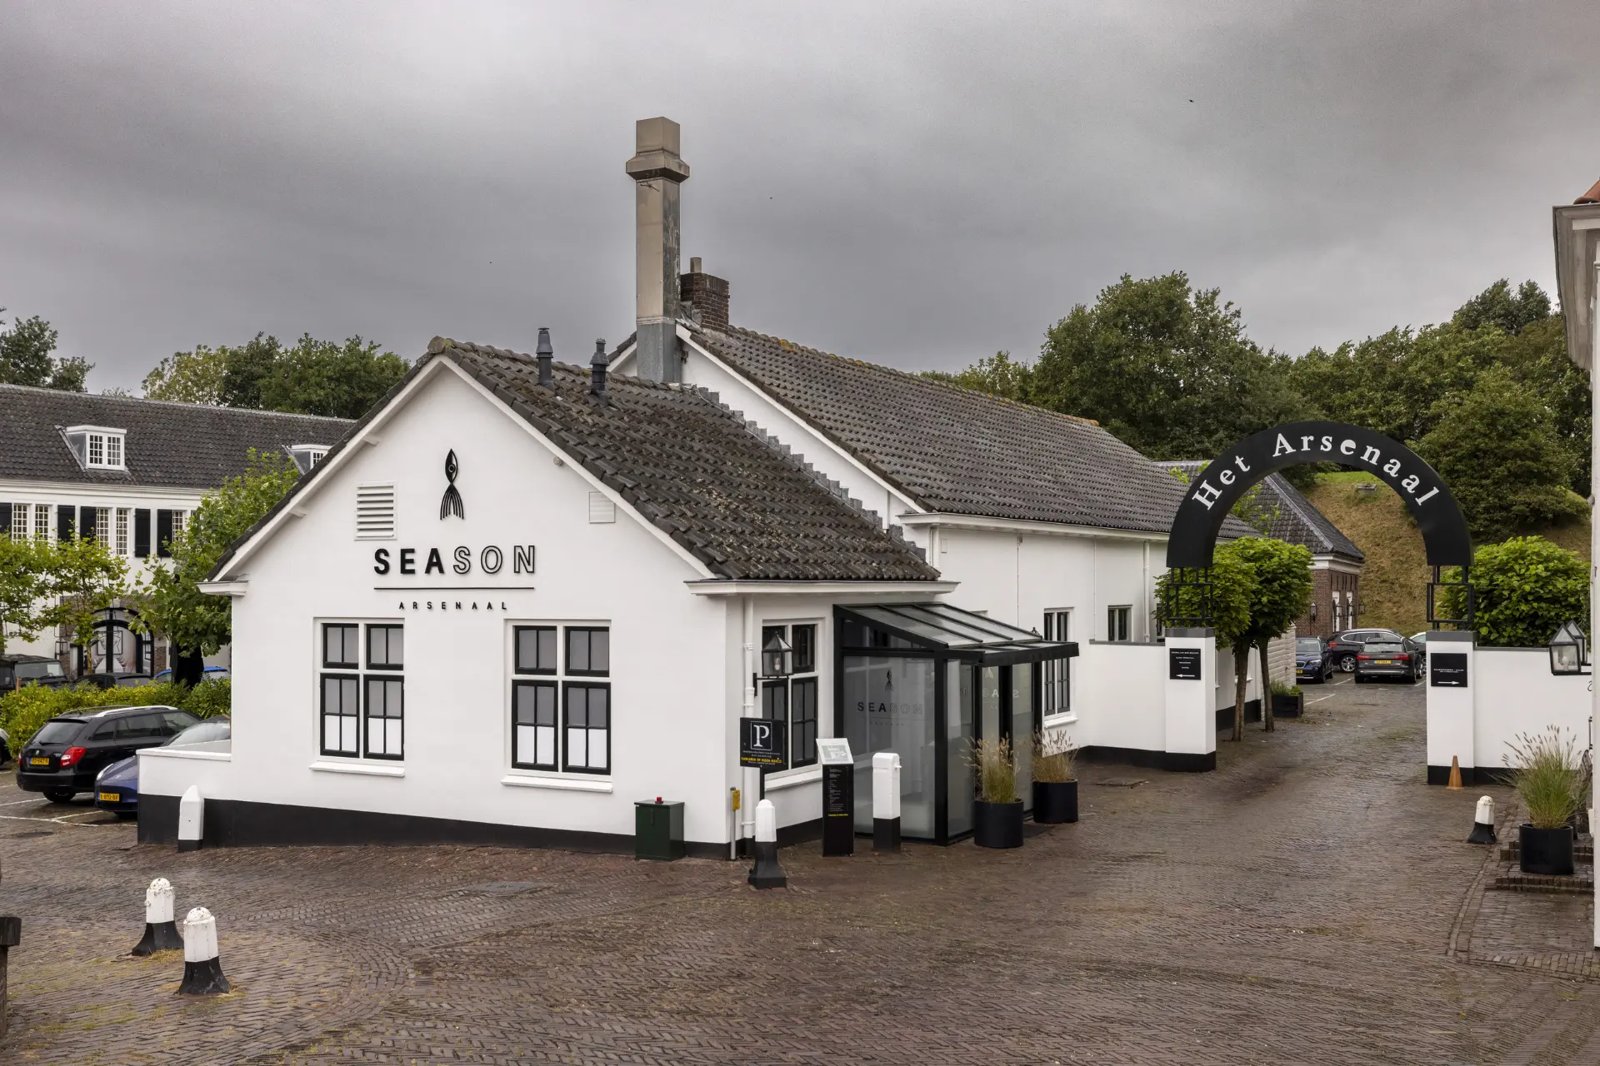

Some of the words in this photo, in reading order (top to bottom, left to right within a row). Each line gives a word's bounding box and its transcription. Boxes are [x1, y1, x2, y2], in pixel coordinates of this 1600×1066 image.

[1192, 454, 1251, 511] Het
[1272, 432, 1440, 506] Arsenaal
[373, 545, 535, 575] SEASON
[399, 601, 507, 610] ARSENAAL
[753, 724, 770, 748] P
